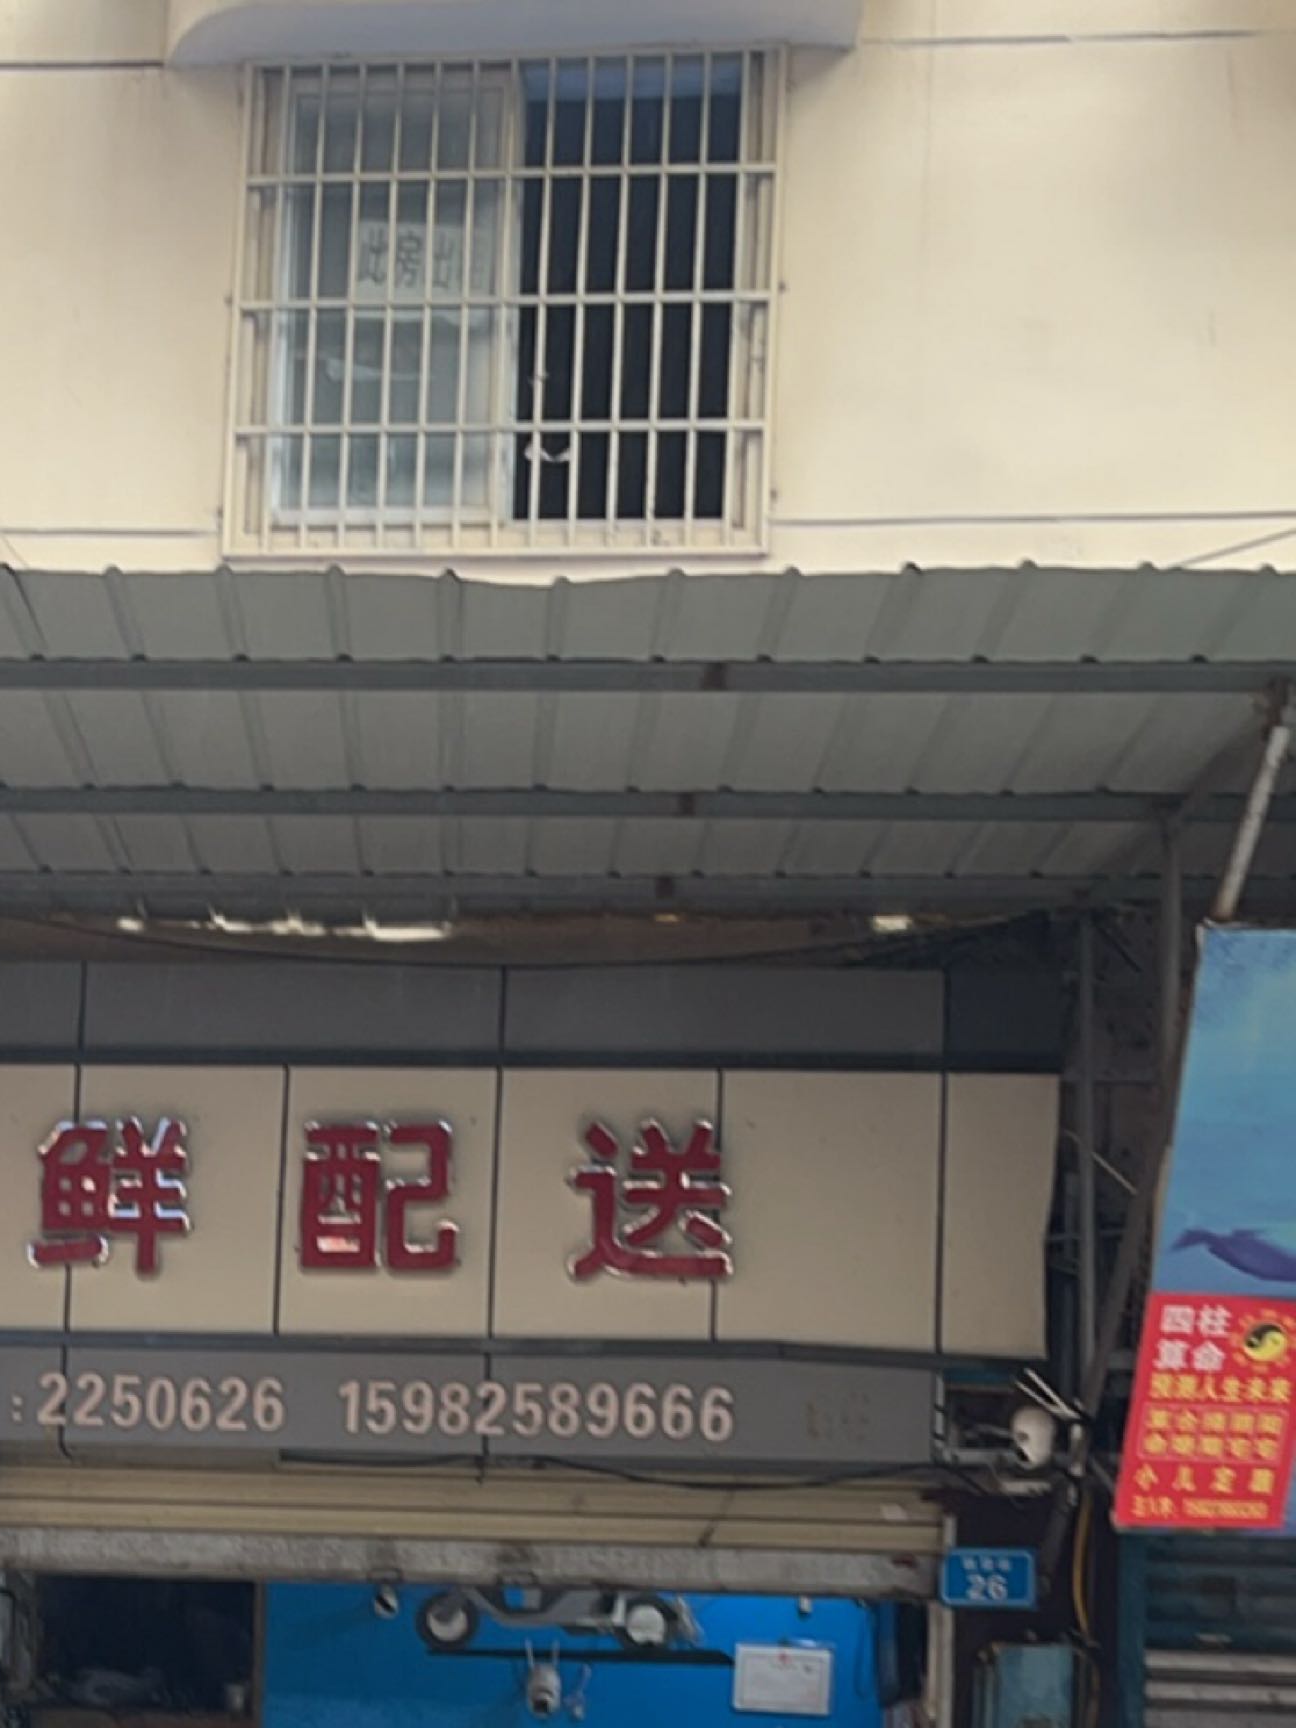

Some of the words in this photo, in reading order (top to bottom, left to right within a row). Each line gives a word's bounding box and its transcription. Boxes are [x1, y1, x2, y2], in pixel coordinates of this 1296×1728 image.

[28, 1114, 734, 1283] 鲜配送
[37, 1371, 285, 1431] 2250626
[338, 1380, 734, 1442] 15982589666
[966, 1574, 1008, 1600] 26
